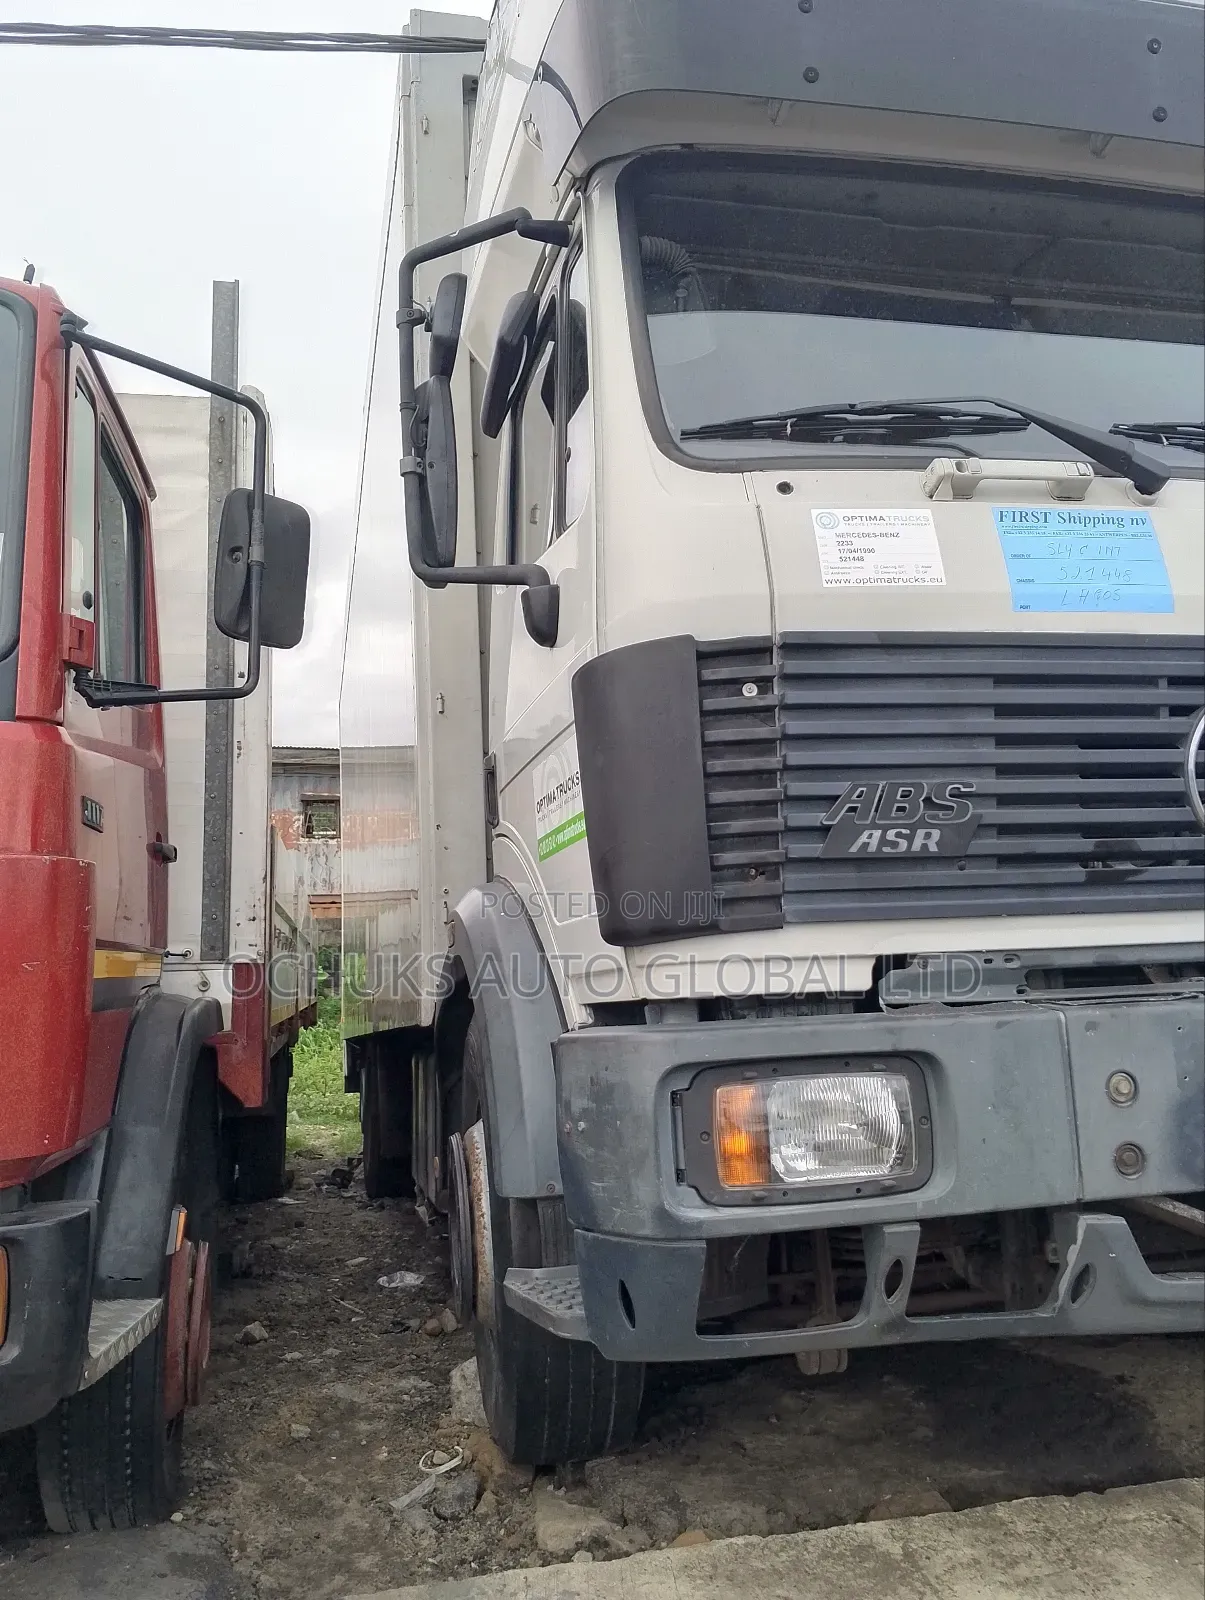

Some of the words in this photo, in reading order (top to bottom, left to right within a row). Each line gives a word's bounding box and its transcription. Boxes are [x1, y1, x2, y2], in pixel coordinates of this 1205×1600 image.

[998, 510, 1052, 524] FIRST
[1057, 511, 1125, 529] Shipping
[1130, 516, 1147, 526] nv
[824, 576, 943, 585] www.optimatrucks.eu
[536, 771, 580, 814] OPTIMATRUCKS
[821, 780, 977, 824] ABS
[848, 828, 941, 853] ASR
